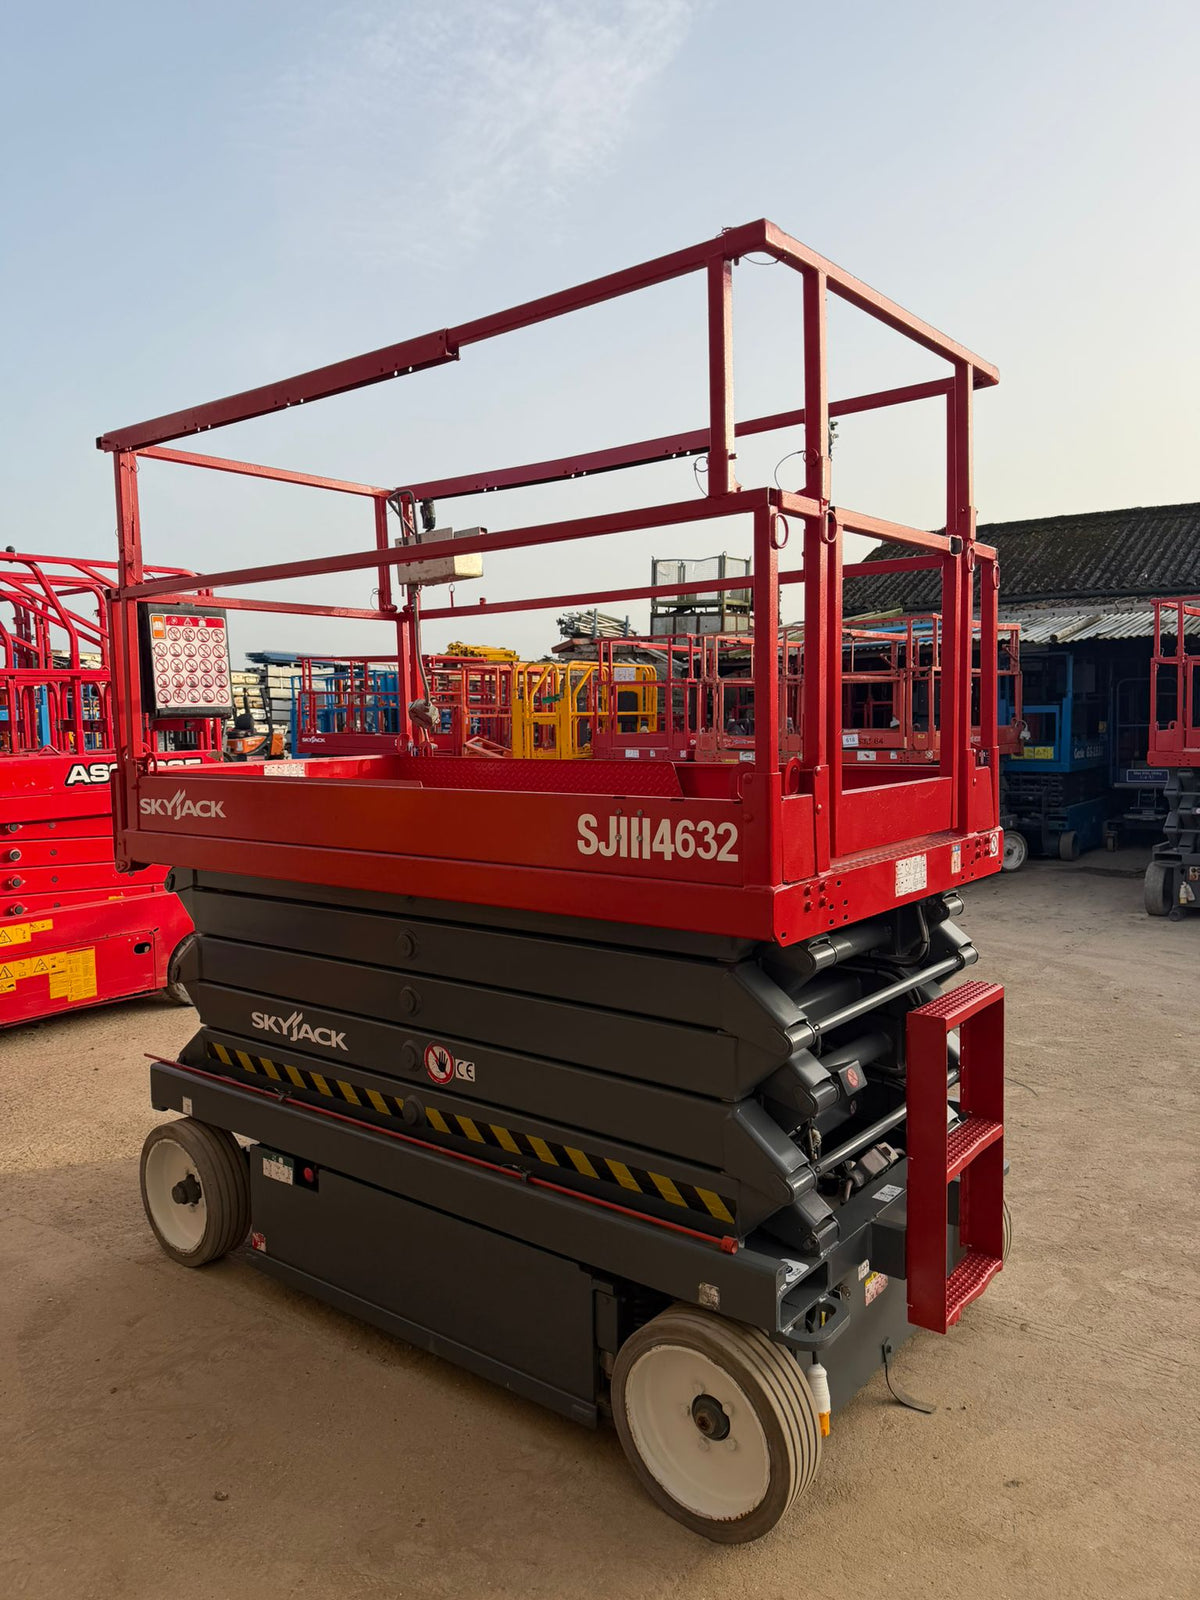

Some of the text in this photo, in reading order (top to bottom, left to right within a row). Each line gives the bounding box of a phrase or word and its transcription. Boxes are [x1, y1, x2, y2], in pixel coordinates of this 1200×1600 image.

[140, 788, 227, 821] SKYJACK
[577, 813, 739, 863] SJIII4632
[251, 1010, 349, 1051] SKYJACK
[457, 1061, 473, 1078] CE
